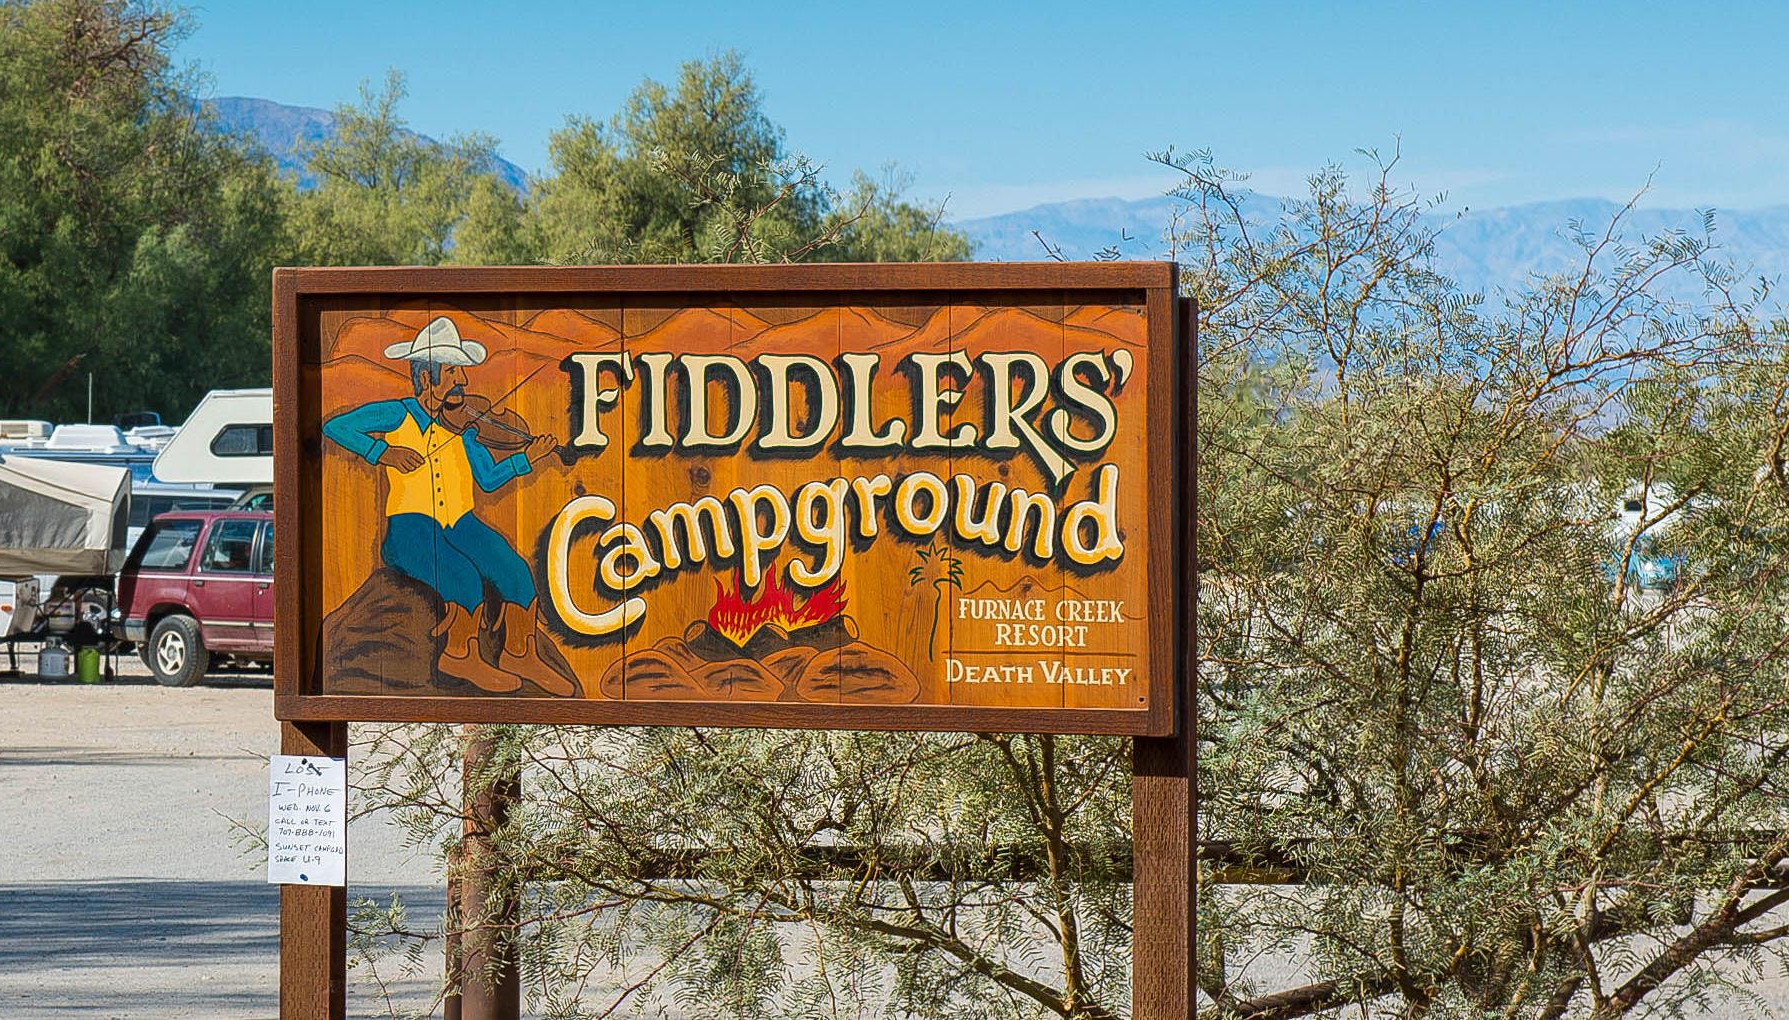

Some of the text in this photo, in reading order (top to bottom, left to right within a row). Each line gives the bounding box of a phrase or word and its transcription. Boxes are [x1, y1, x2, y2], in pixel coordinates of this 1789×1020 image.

[565, 349, 1135, 482] FIDDLERS'
[545, 463, 1124, 635] Campground
[958, 597, 1125, 624] FURNACE CREEK
[995, 622, 1088, 648] RESORT
[324, 804, 331, 813] 6
[314, 818, 337, 827] TEXT
[275, 843, 312, 852] SUNSET
